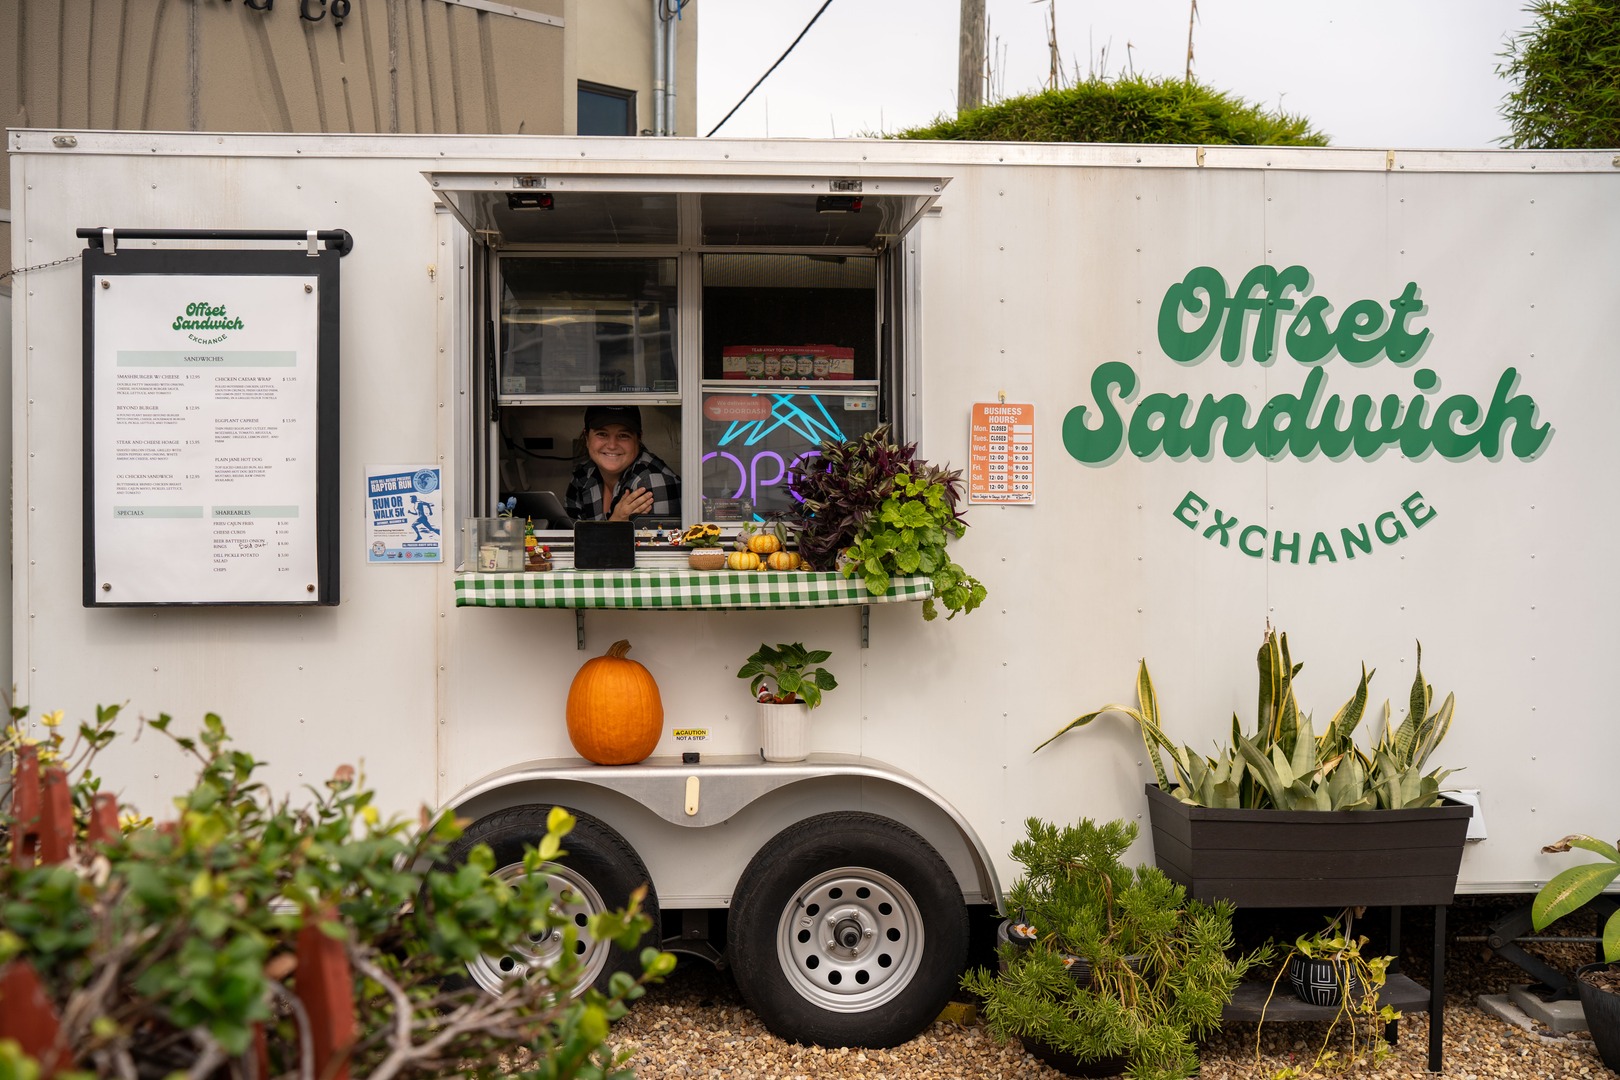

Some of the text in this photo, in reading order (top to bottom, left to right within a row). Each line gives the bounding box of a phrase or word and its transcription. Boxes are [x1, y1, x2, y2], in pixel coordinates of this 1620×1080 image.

[186, 302, 226, 316] Offset
[1157, 264, 1433, 367] Offset
[172, 316, 244, 330] Sandwich
[188, 334, 228, 344] EXCHANGE
[984, 407, 1022, 415] BUSINESS
[1062, 360, 1555, 468] Sandwich
[371, 482, 397, 493] RAPTOR
[398, 480, 412, 489] RUN
[372, 496, 403, 509] RUN OR
[374, 508, 405, 519] WALK 5K
[1172, 490, 1438, 565] EXCHANGE
[489, 560, 495, 569] 5
